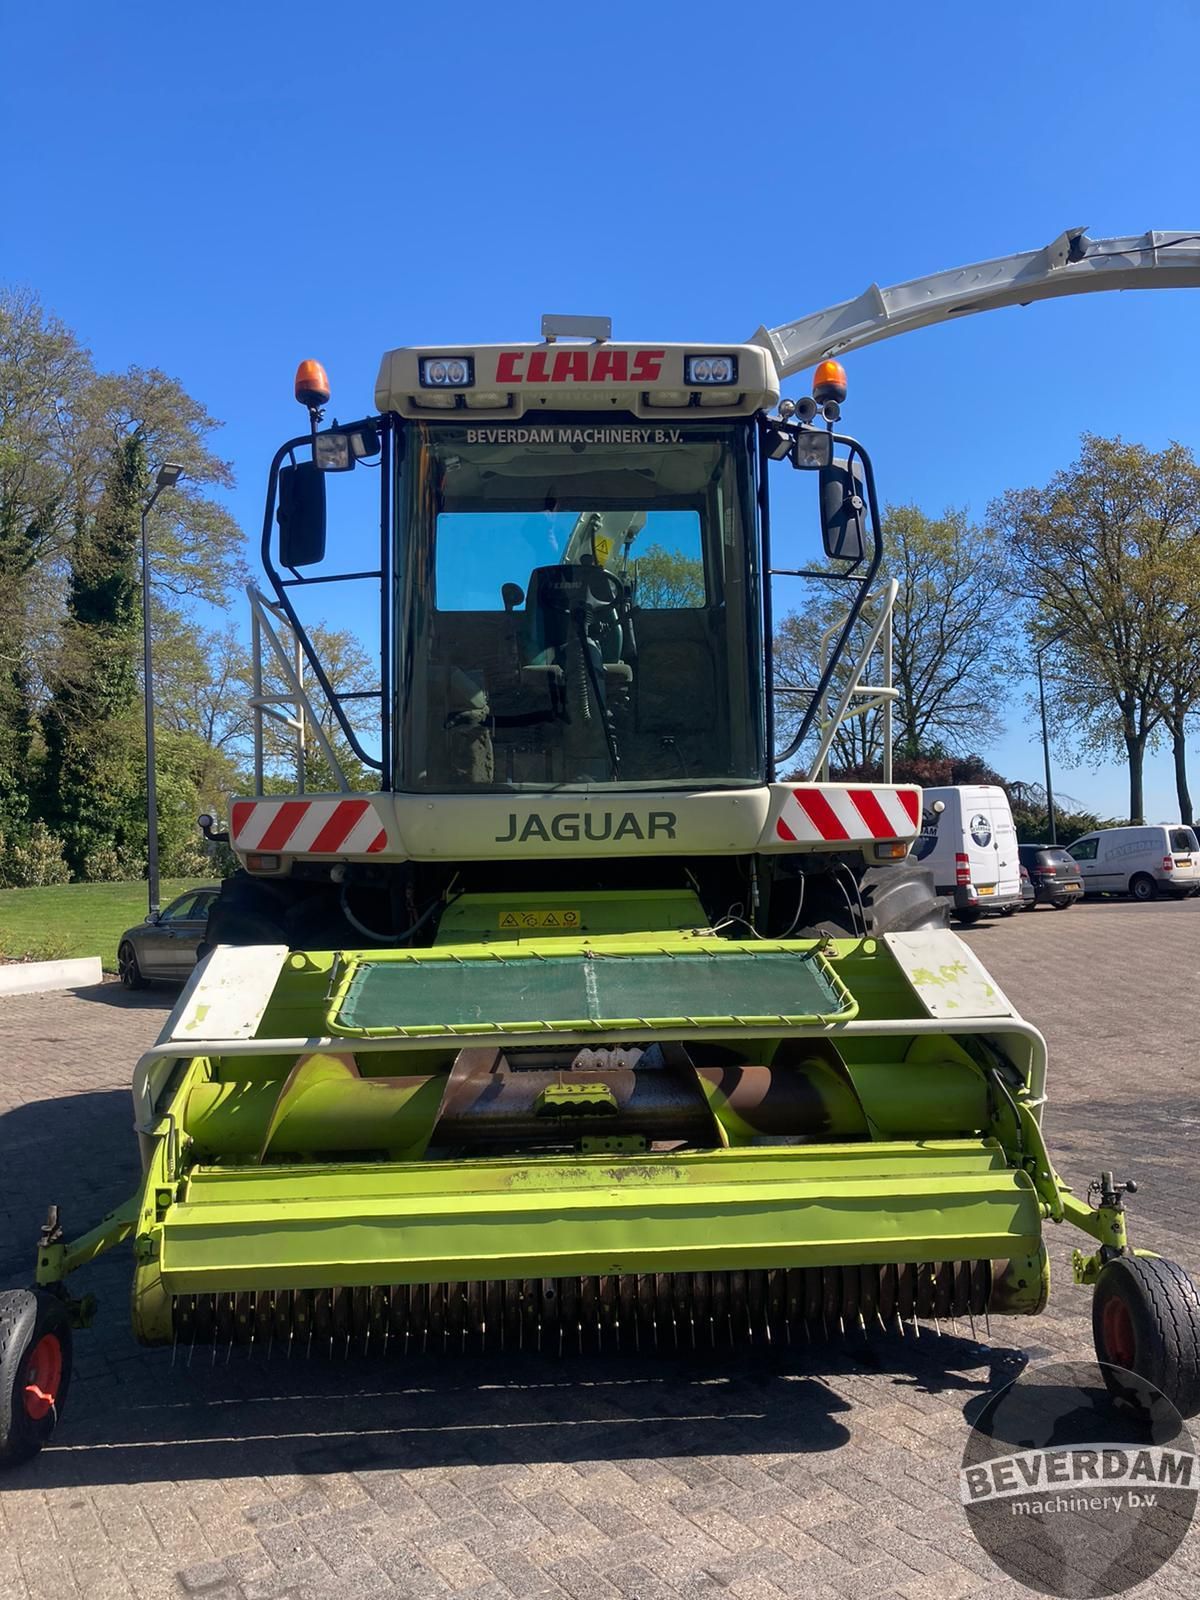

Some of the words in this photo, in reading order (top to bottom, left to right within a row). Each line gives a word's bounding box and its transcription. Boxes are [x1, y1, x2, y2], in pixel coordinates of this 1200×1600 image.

[495, 350, 666, 383] CLAAS
[466, 429, 554, 443] BEVERDAM
[558, 429, 651, 443] MACHINERY
[655, 429, 684, 443] B.V.
[495, 811, 677, 842] JAGUAR
